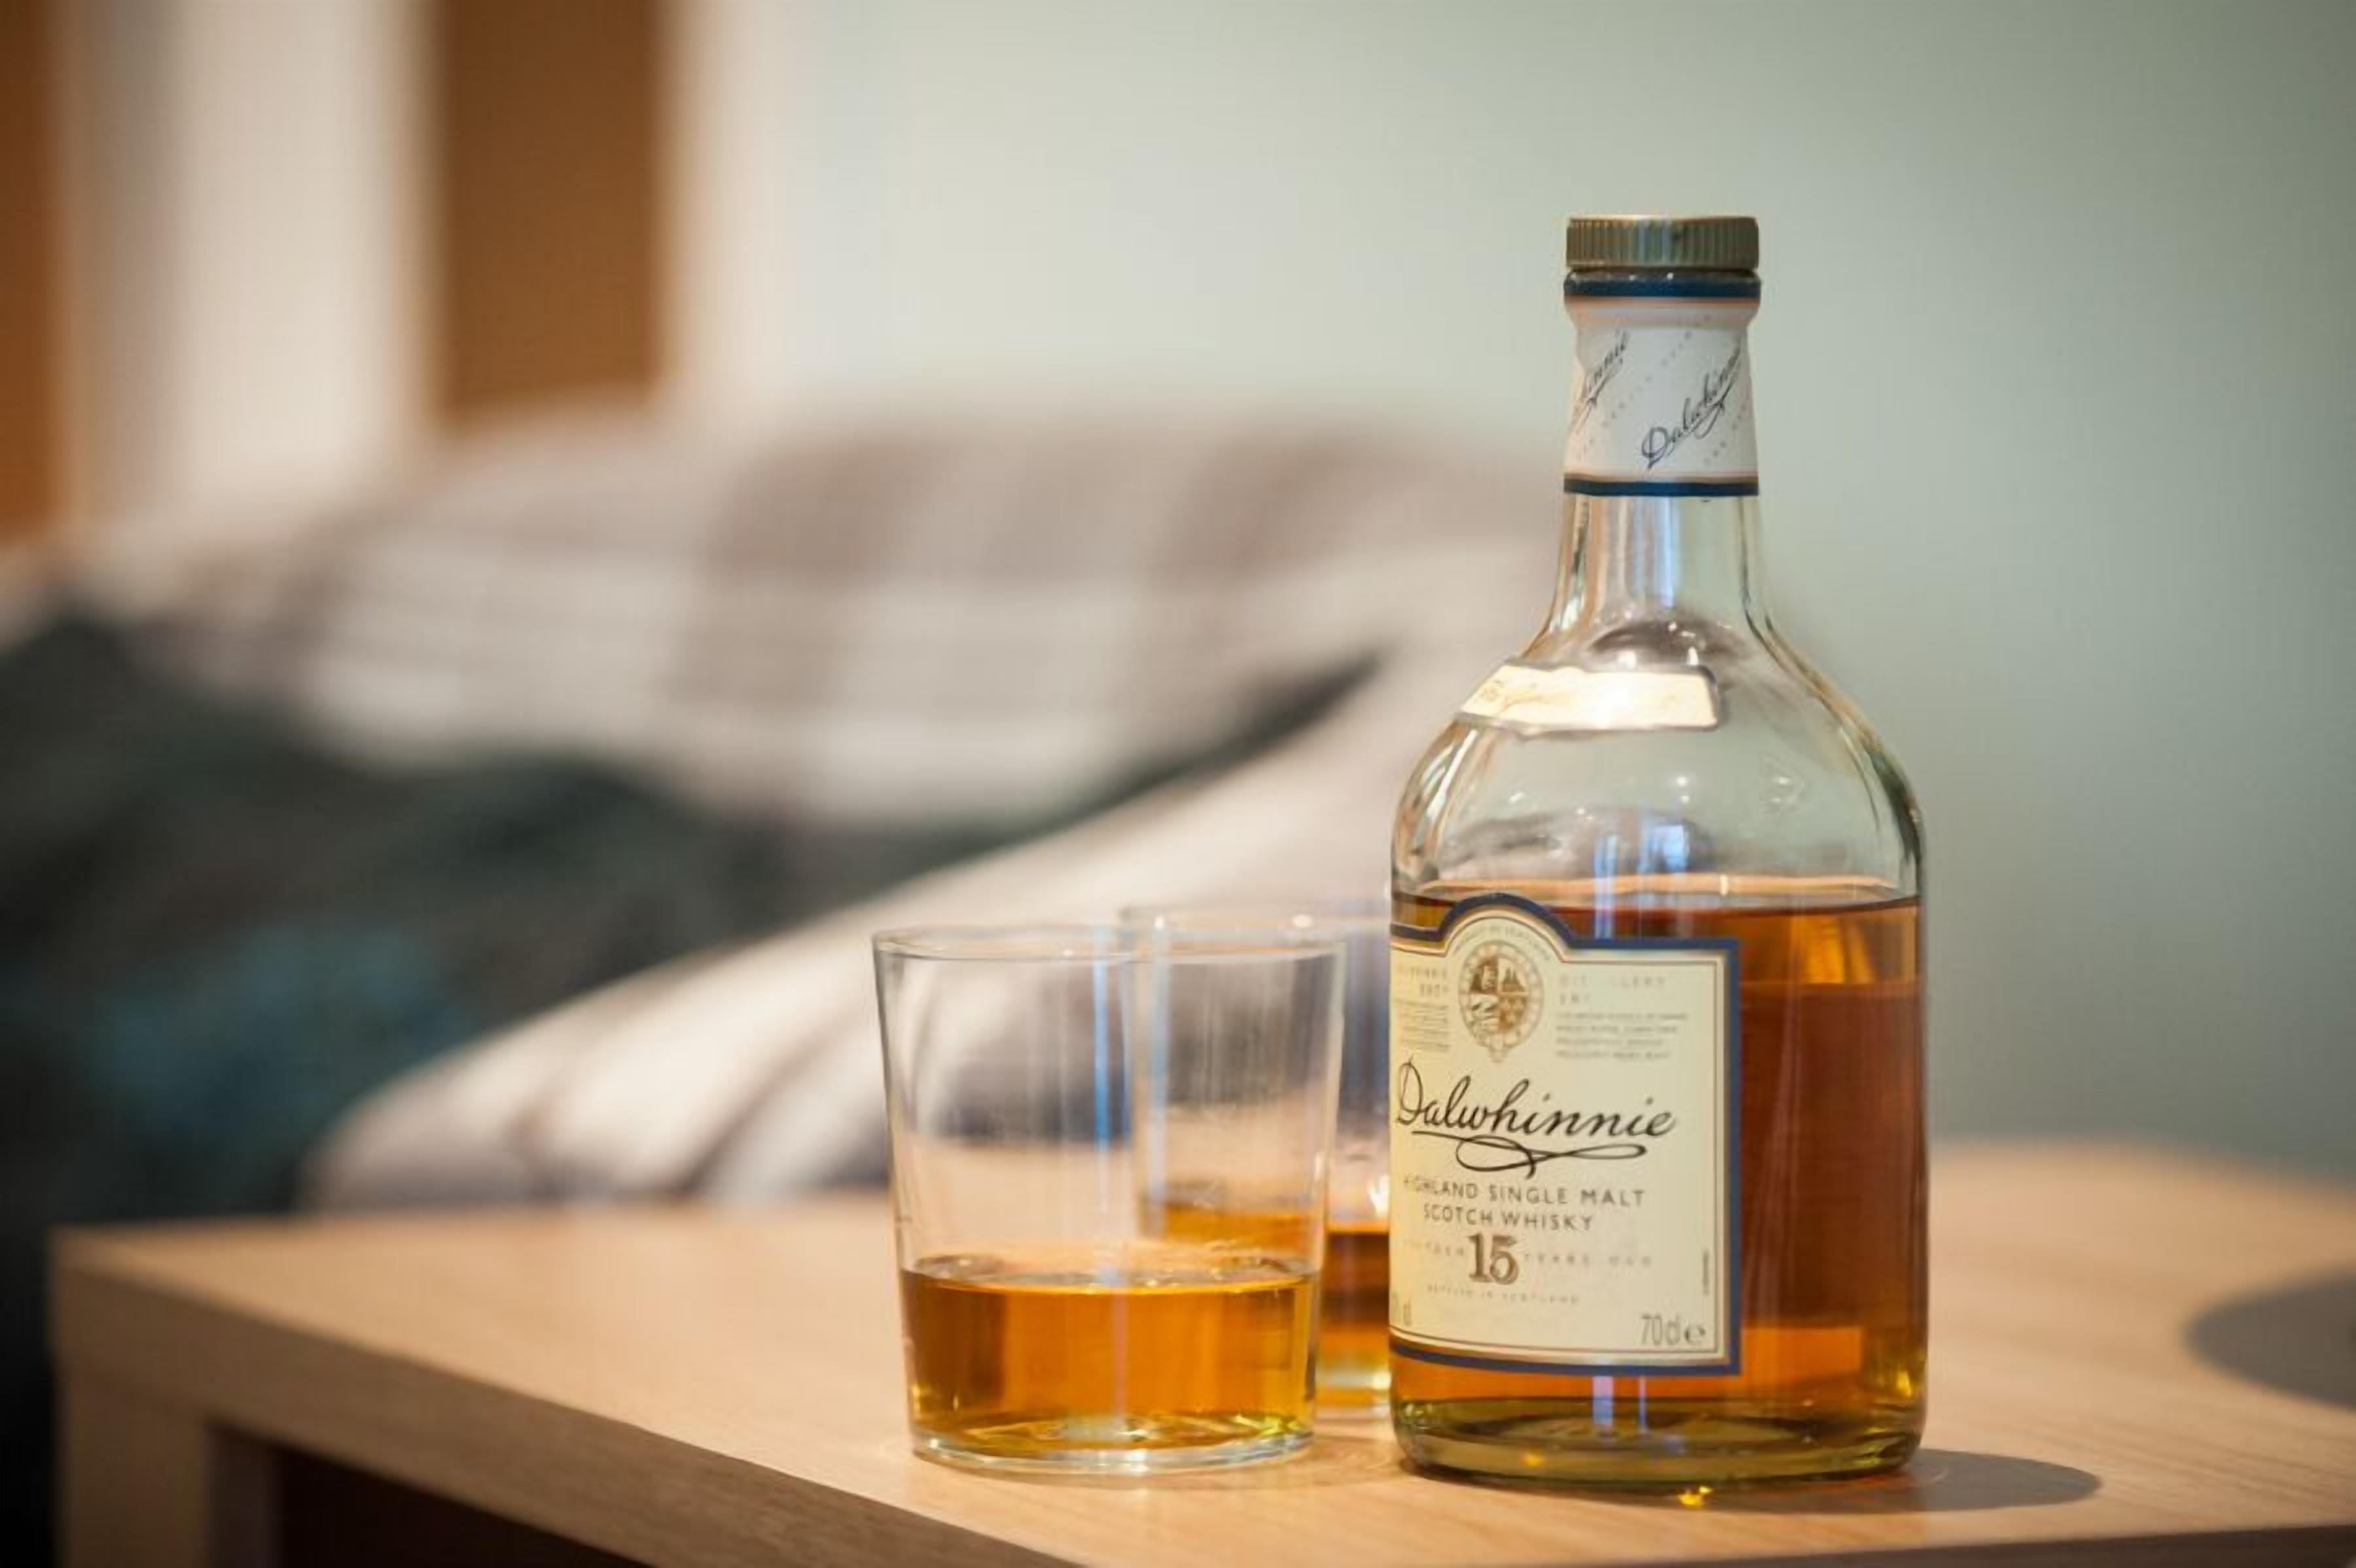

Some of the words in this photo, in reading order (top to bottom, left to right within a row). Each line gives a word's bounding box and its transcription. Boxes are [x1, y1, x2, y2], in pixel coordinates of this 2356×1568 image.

[1397, 1060, 1677, 1139] Dalwhinnie
[1488, 1183, 1567, 1205] SINGLE
[1580, 1188, 1646, 1208] MALT
[1423, 1202, 1493, 1226] SCOTCH
[1501, 1209, 1593, 1232] WHISKY
[1467, 1232, 1520, 1285] 15
